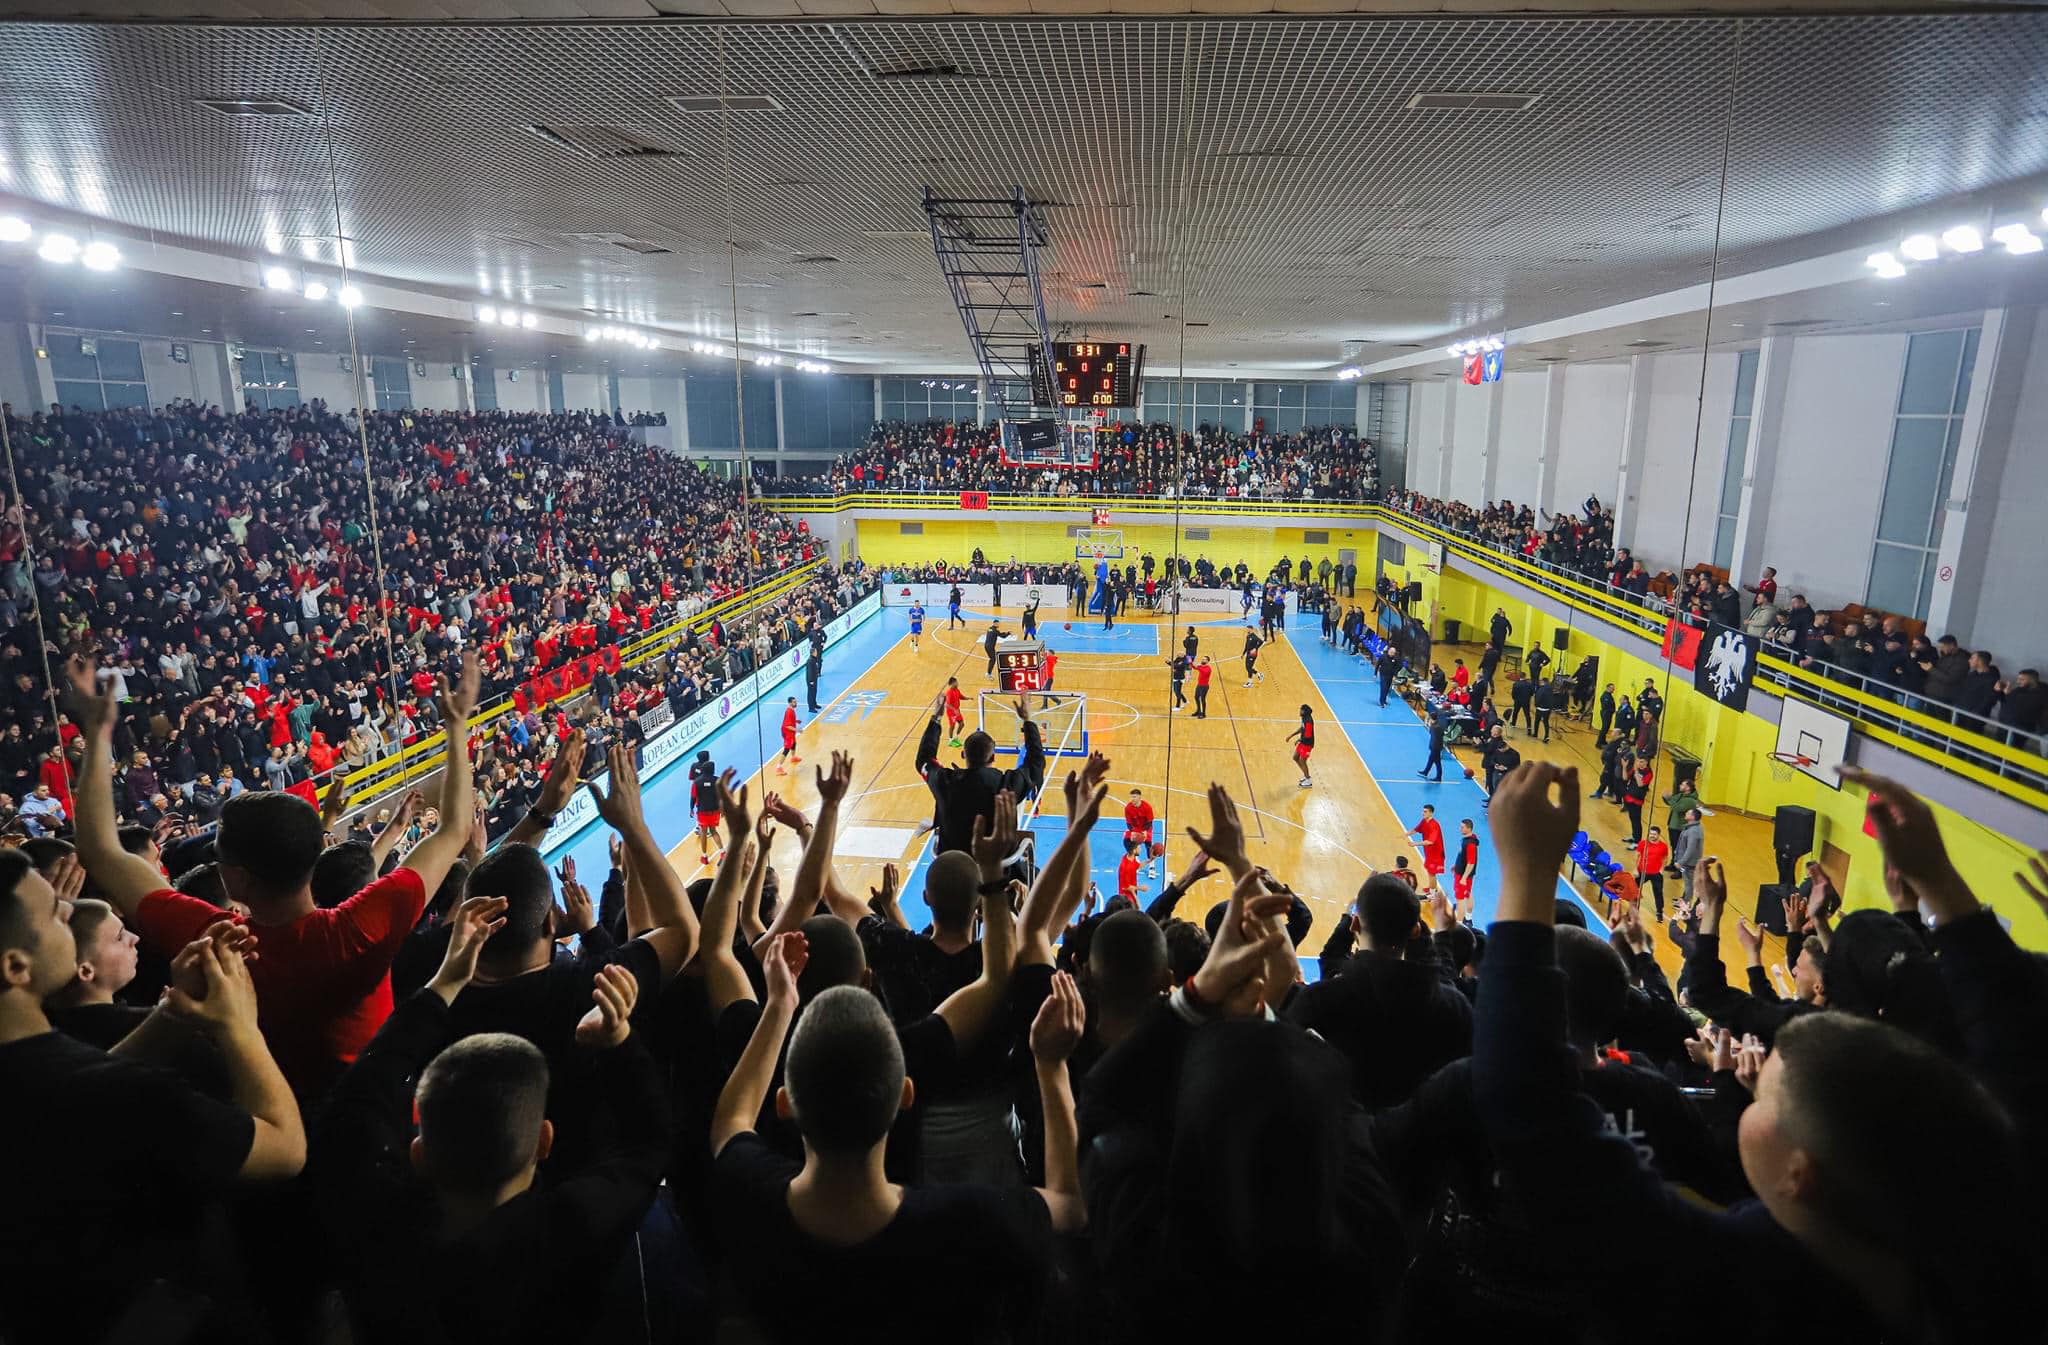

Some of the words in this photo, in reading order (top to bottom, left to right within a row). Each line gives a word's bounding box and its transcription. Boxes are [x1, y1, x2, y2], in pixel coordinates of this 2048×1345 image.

[1081, 362, 1088, 373] 0
[1106, 362, 1113, 373] 0
[1069, 378, 1076, 389] 0
[1103, 378, 1110, 390] 0
[1008, 654, 1038, 667] 9:31
[1014, 672, 1039, 691] 24
[680, 713, 708, 740] CLINIC
[553, 794, 588, 829] LINIC
